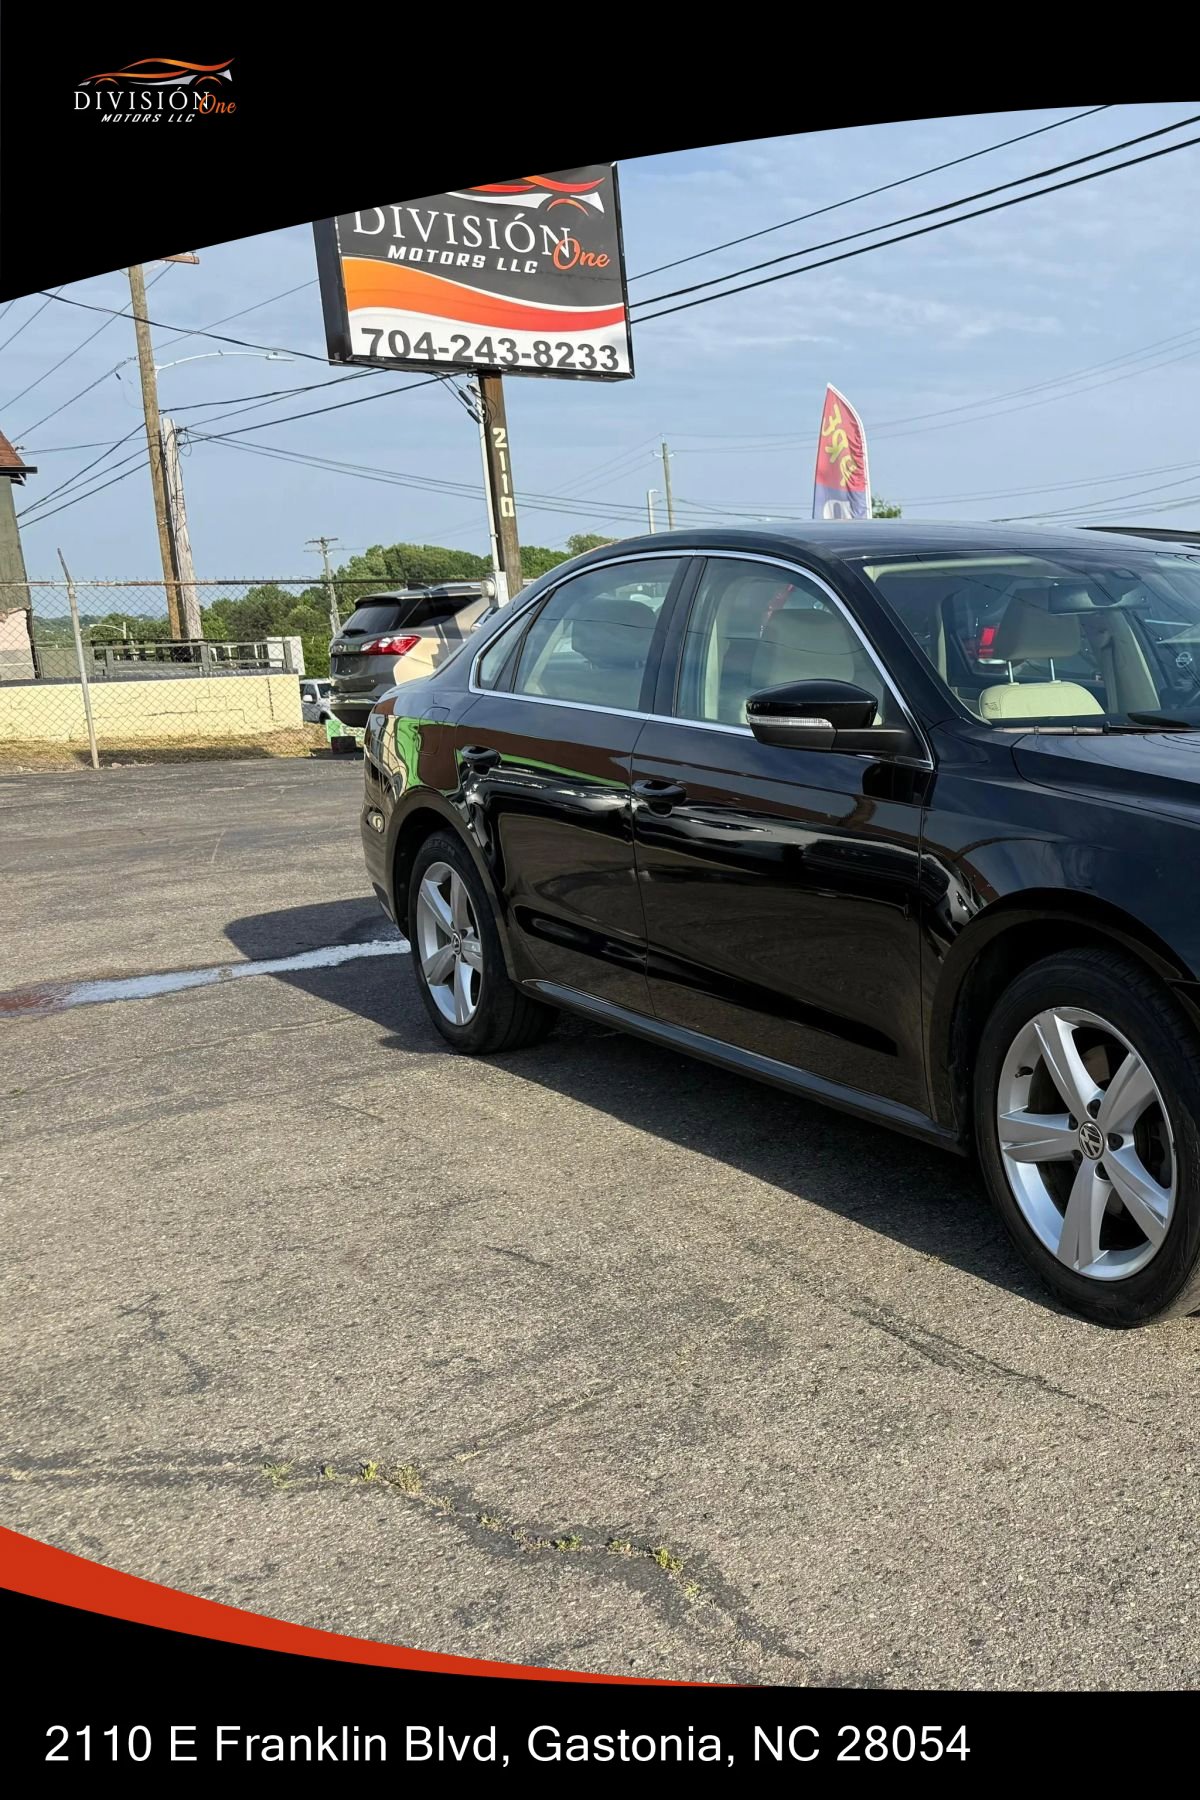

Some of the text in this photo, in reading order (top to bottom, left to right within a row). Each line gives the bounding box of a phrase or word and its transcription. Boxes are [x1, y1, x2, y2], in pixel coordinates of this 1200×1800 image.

[353, 205, 570, 258] DIVISIÓN
[387, 245, 539, 274] MOTORS LLC
[553, 238, 610, 270] One
[361, 327, 619, 371] 704-243-8233
[493, 427, 515, 517] 2110
